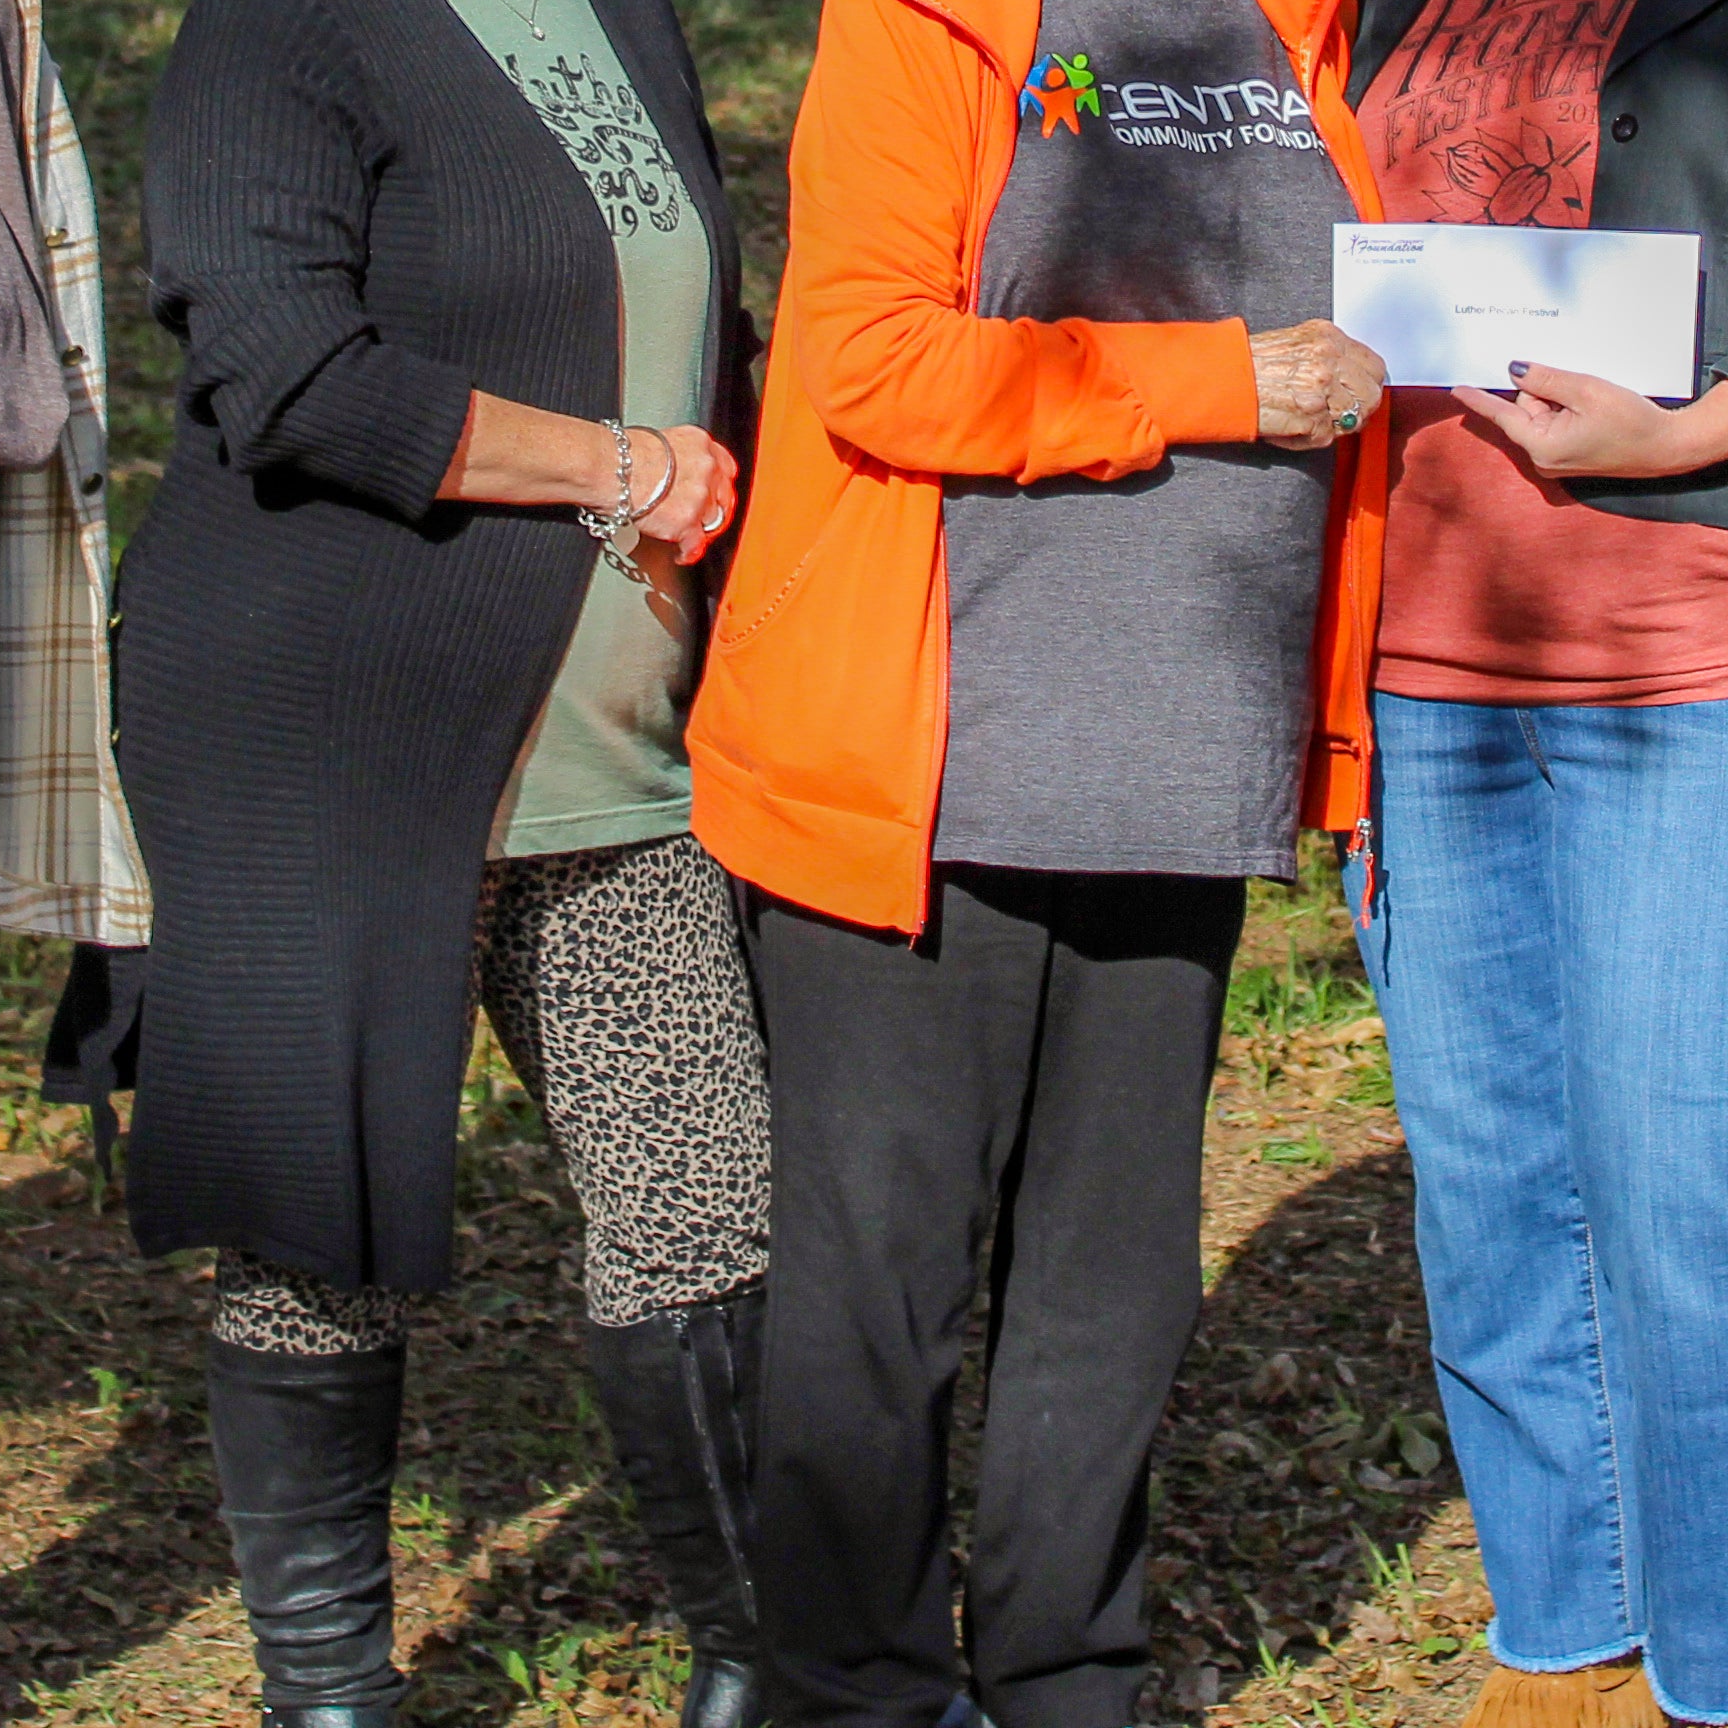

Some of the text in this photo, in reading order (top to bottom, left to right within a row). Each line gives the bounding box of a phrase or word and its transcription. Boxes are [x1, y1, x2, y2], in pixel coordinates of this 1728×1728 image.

[1110, 123, 1233, 154] OMMUNITY
[1357, 240, 1424, 253] Foundation
[1455, 304, 1486, 314] Luther
